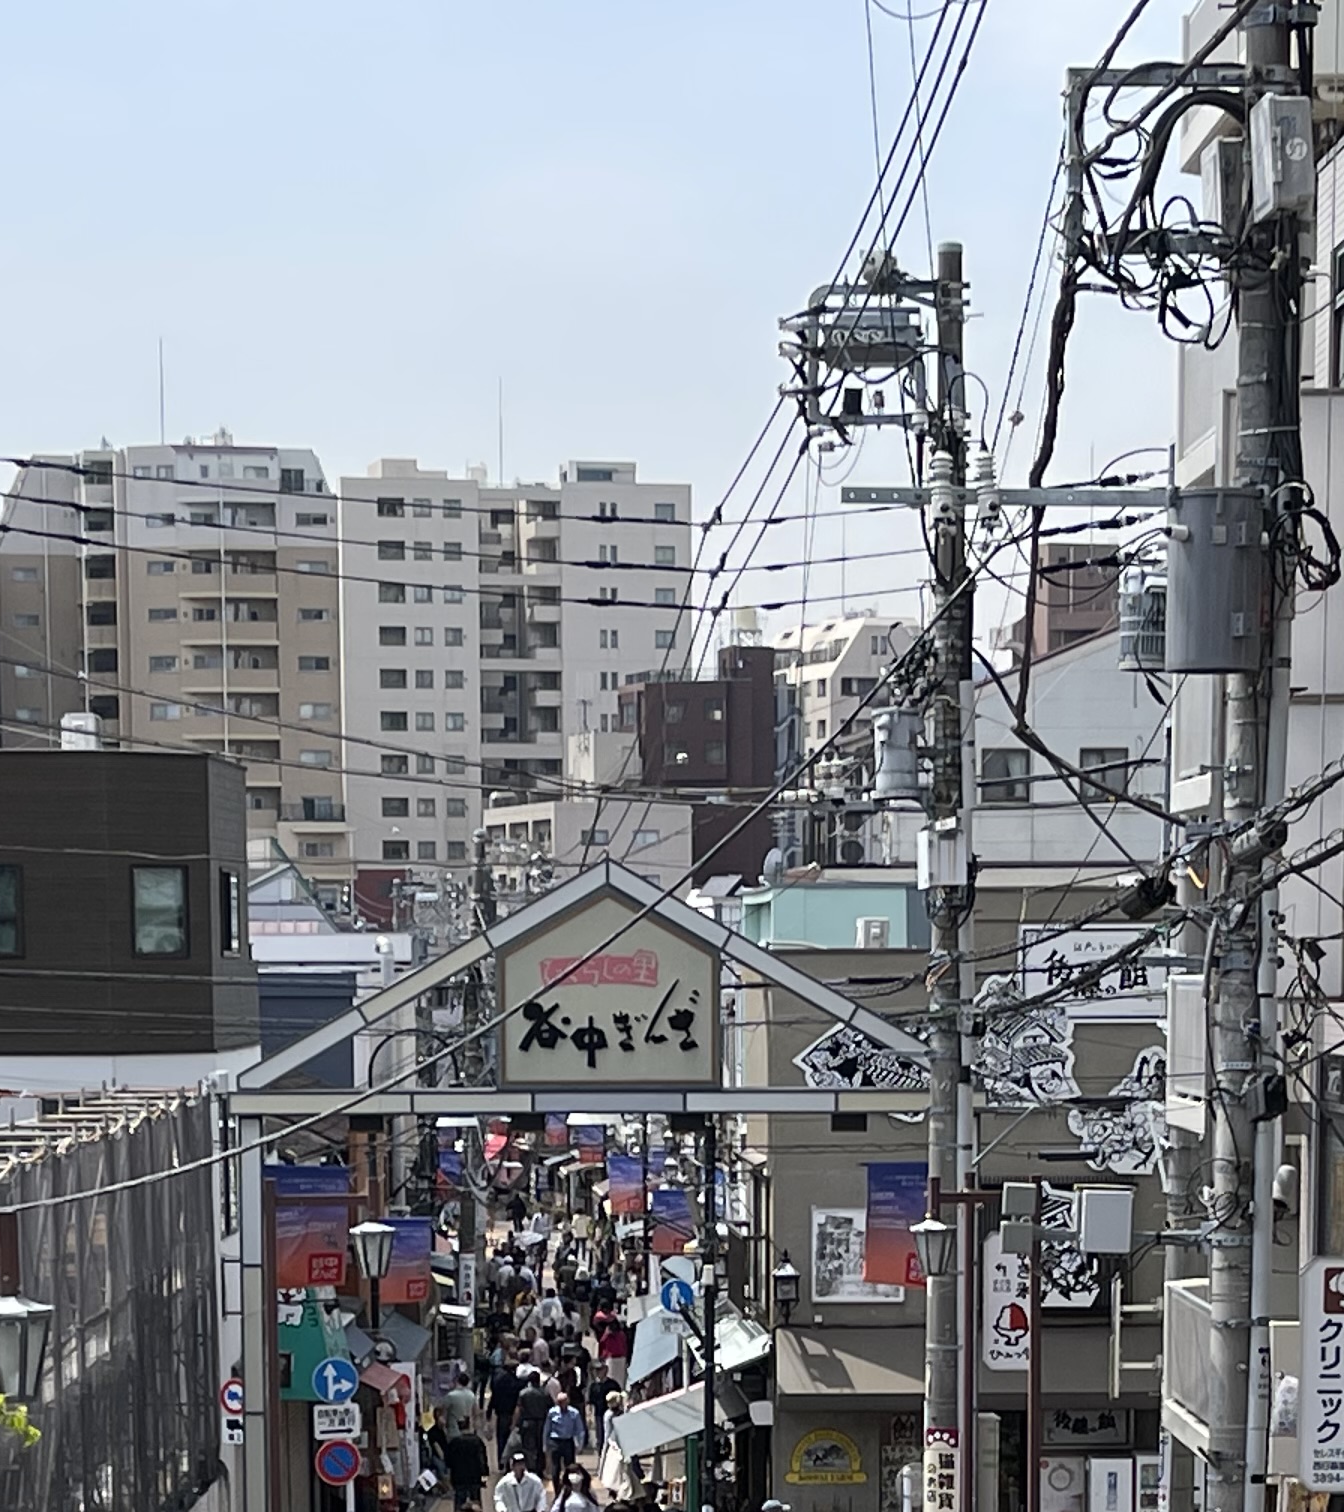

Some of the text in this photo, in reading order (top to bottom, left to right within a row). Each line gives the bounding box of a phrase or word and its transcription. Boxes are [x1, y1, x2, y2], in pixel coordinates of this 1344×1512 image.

[519, 979, 700, 1069] 谷中ぎんざ
[1316, 1318, 1343, 1444] クリニック
